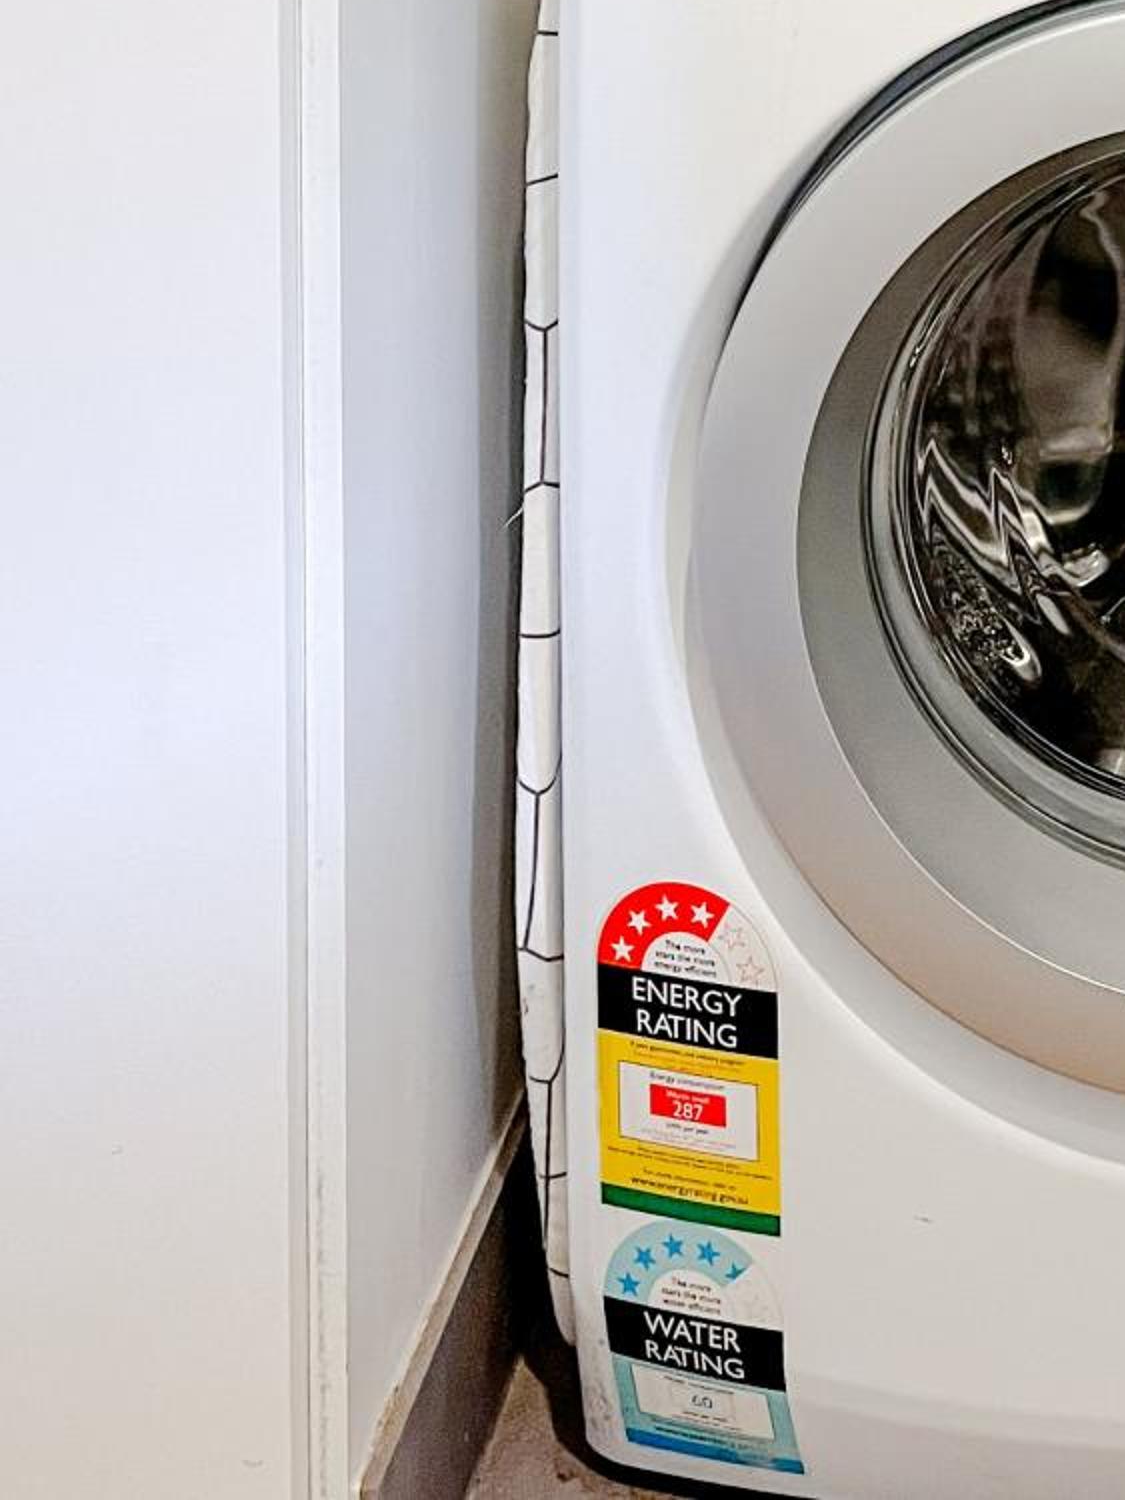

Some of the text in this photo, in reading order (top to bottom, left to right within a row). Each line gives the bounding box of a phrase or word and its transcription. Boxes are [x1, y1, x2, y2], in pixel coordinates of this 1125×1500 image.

[632, 976, 742, 1017] ENERGY
[636, 1010, 737, 1049] RATING
[672, 1100, 703, 1121] 287
[644, 1311, 740, 1353] WATER
[644, 1340, 744, 1379] RATING
